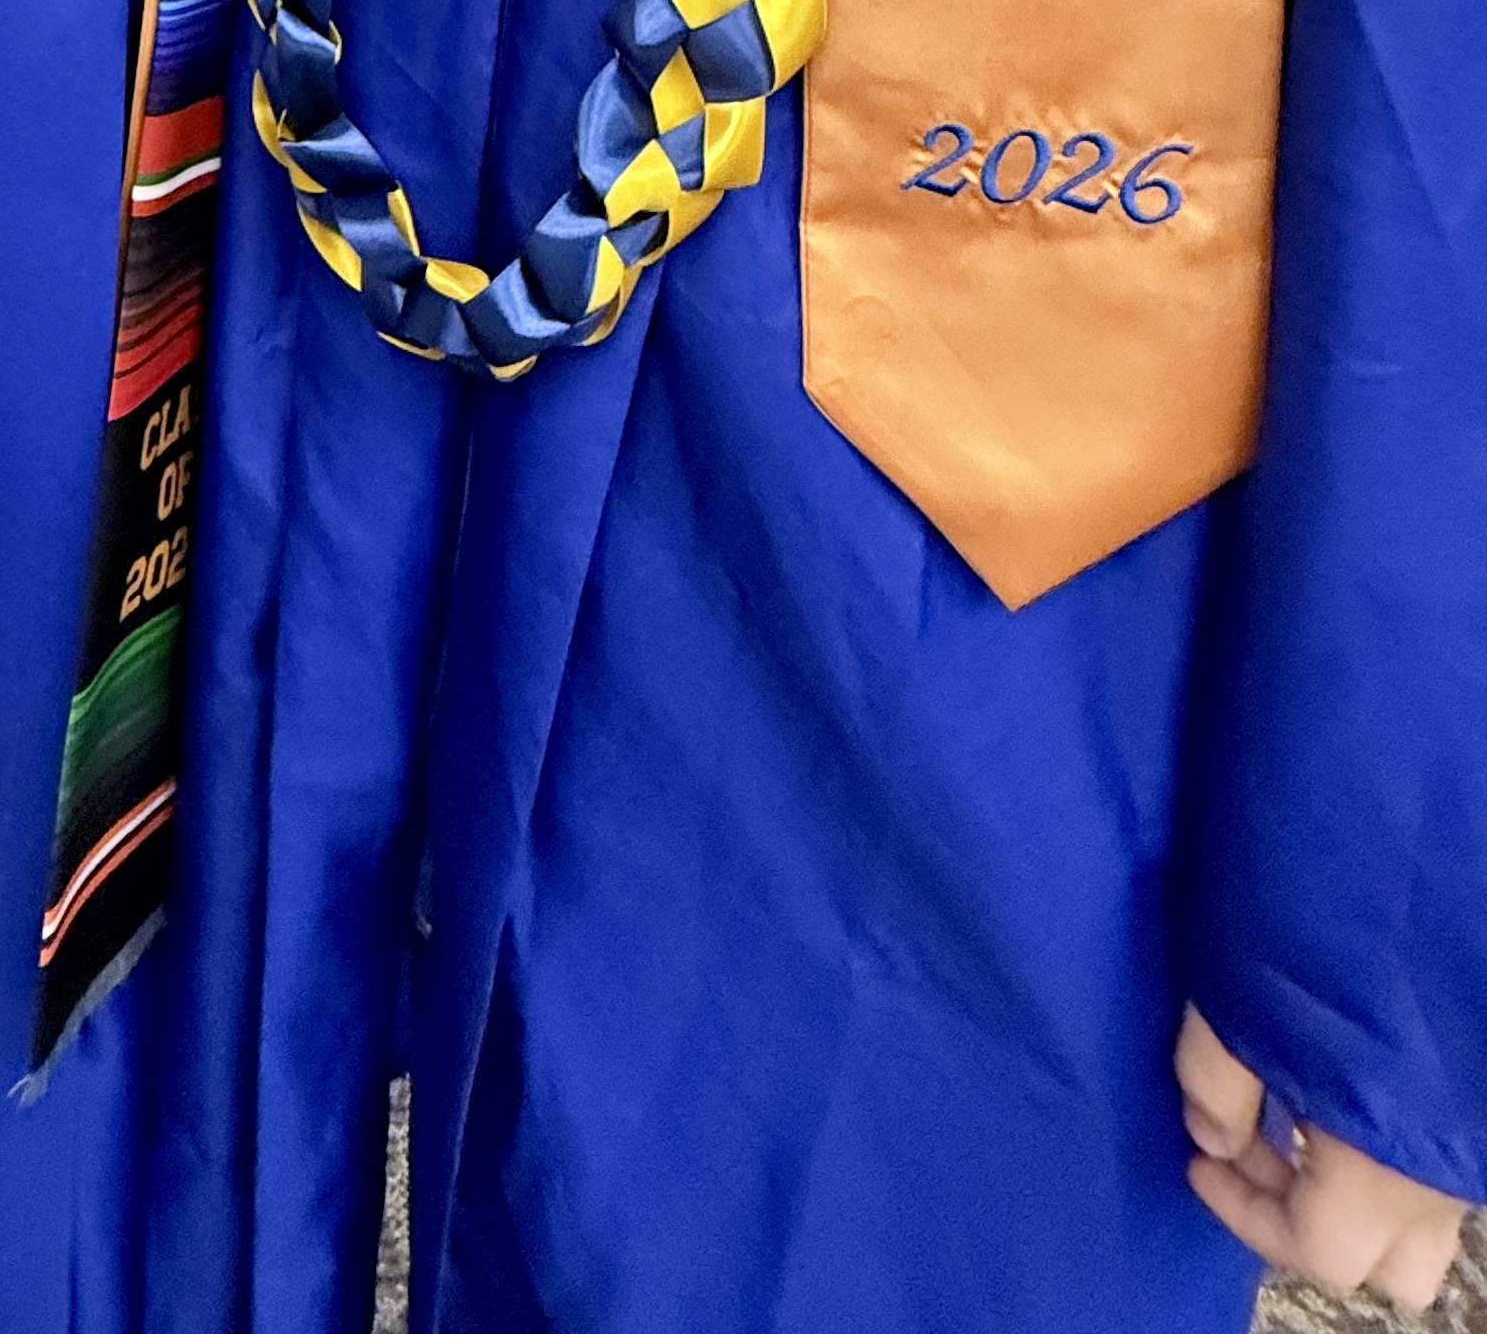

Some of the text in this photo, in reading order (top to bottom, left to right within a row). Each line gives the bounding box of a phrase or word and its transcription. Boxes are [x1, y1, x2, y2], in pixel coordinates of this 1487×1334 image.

[899, 122, 1195, 225] 2026
[139, 383, 192, 472] CLA
[157, 449, 195, 522] OF
[118, 525, 189, 624] 202
